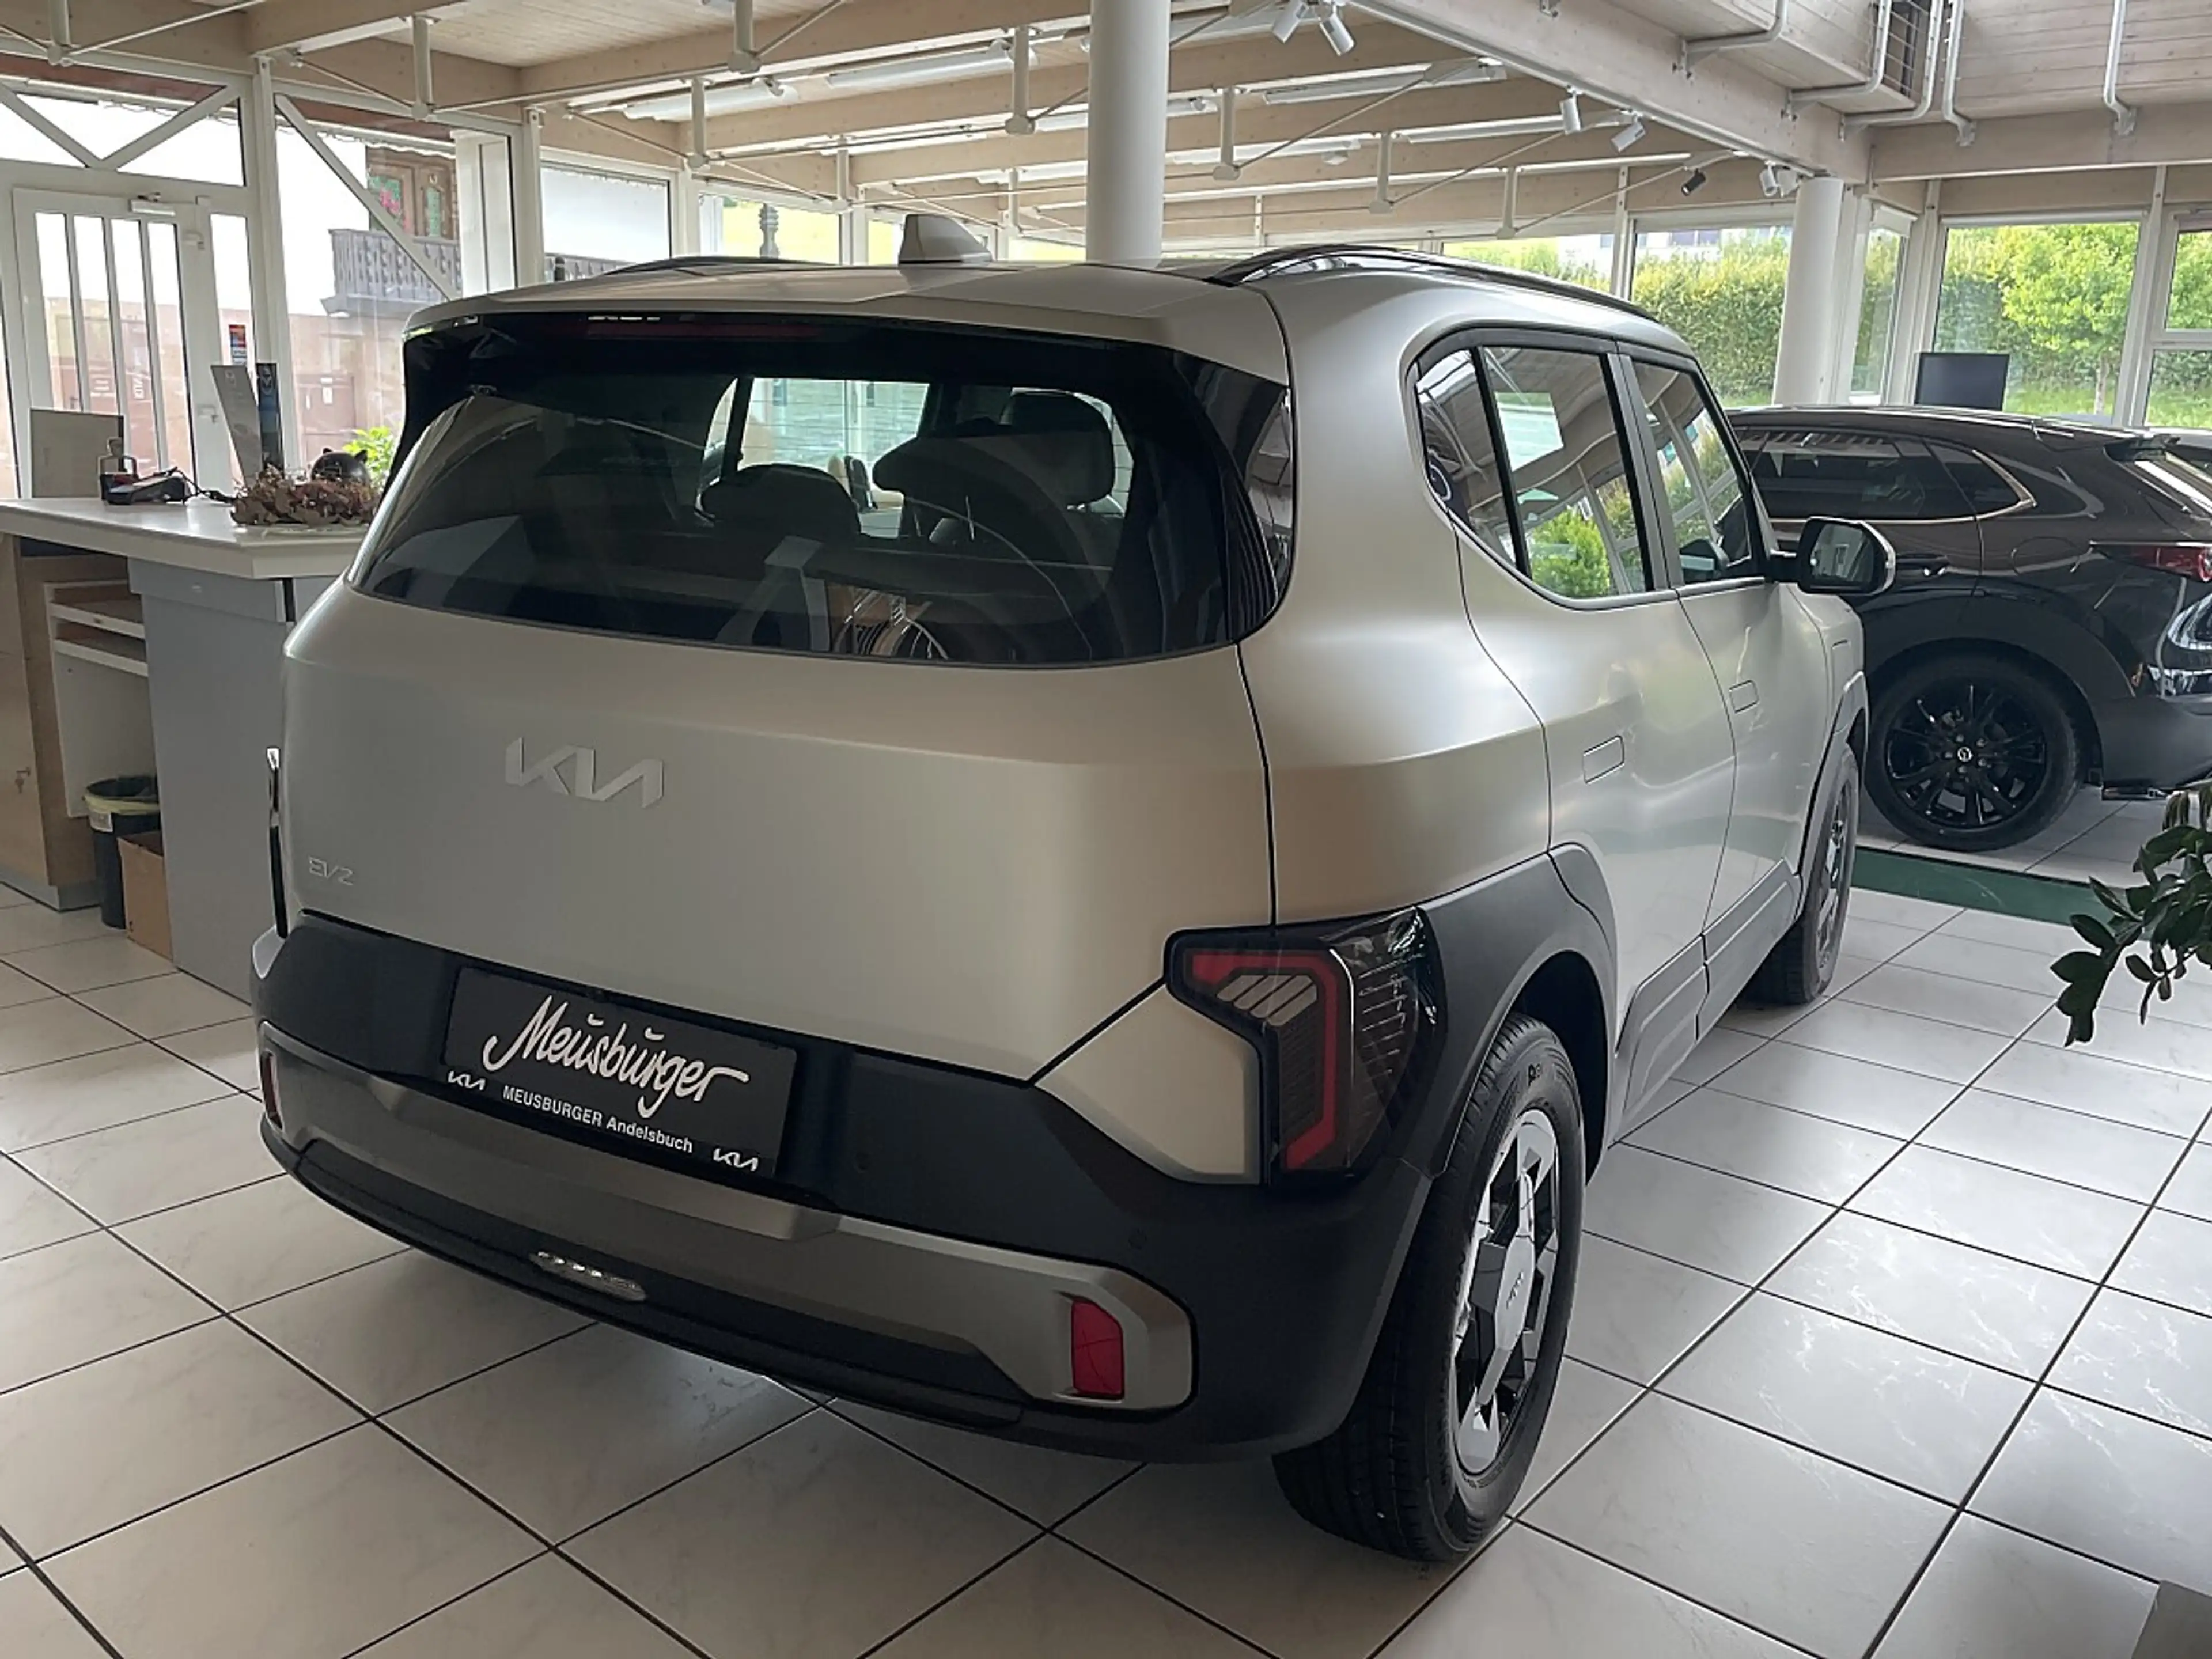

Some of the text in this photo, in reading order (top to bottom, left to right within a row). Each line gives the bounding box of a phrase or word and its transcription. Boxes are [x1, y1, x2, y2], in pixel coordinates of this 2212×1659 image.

[505, 737, 664, 808] KIA
[309, 856, 353, 886] EV2
[447, 1070, 486, 1091] KIA
[502, 1085, 693, 1153] MEUSBURGER Andelsbuch
[713, 1147, 759, 1172] KIA
